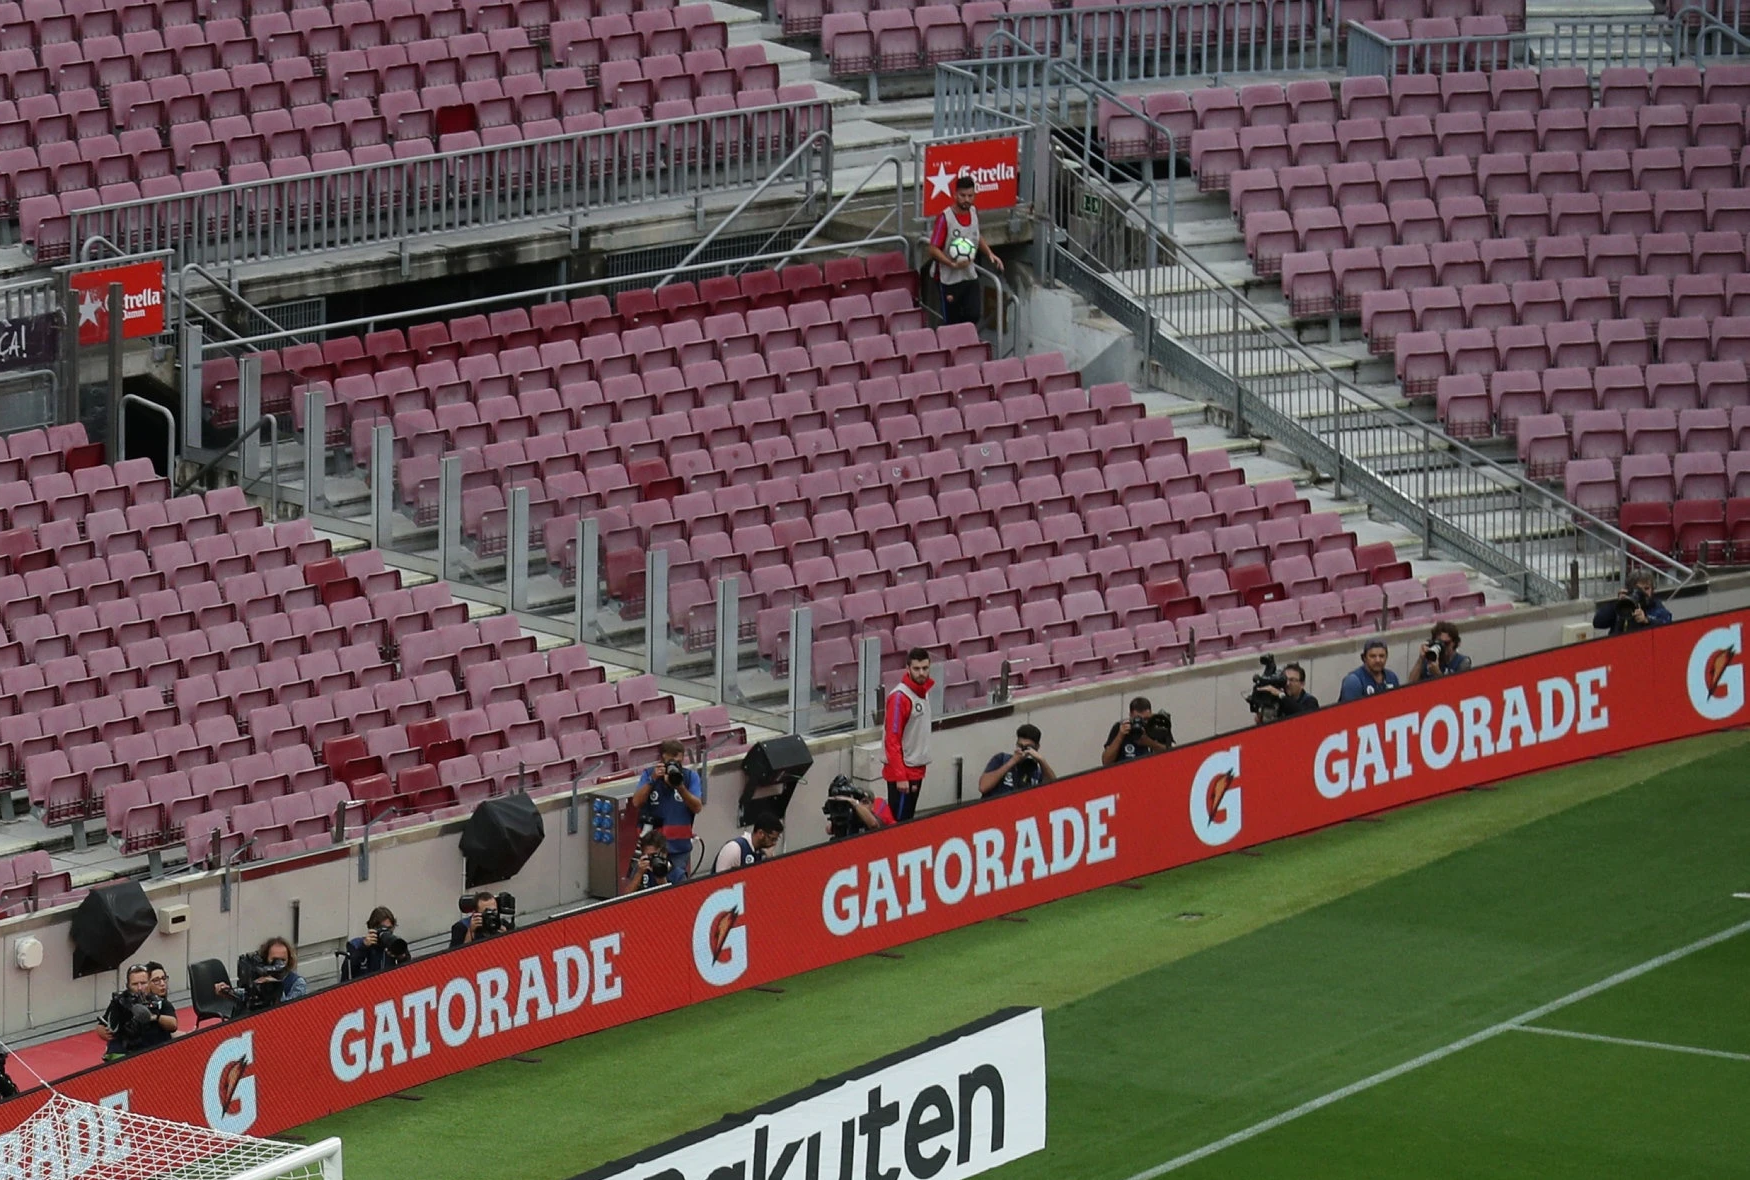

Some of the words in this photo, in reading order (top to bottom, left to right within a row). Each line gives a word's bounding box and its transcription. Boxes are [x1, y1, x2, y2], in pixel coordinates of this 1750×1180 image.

[958, 162, 1015, 183] Estrella
[105, 288, 161, 311] trella
[1687, 623, 1744, 720] G
[1313, 666, 1609, 799] GATORADE
[1189, 746, 1242, 846] G
[822, 794, 1117, 936] GATORADE
[692, 882, 748, 987] G
[329, 932, 623, 1083] GATORADE
[202, 1031, 258, 1135] G
